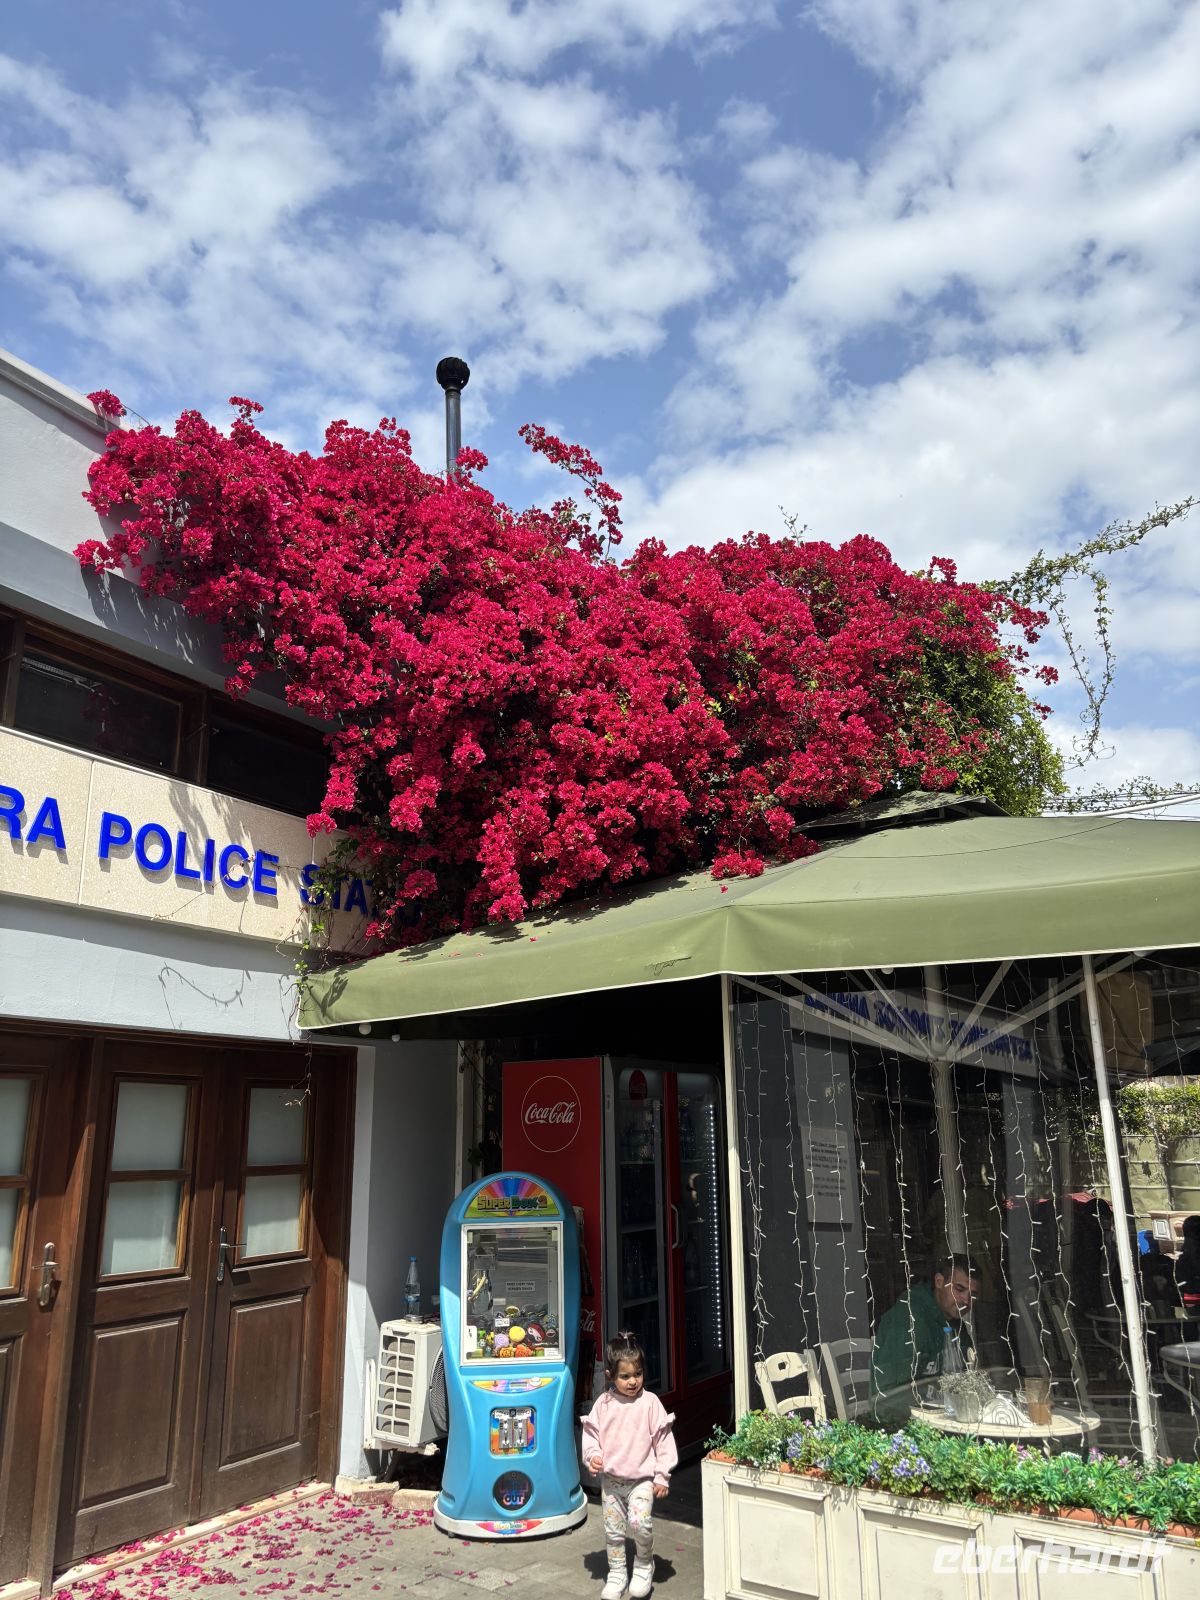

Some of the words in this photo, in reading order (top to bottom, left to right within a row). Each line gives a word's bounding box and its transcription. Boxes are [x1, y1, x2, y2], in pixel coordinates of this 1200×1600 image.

[98, 811, 279, 895] POLICE
[524, 1101, 578, 1125] Coca-Cola
[477, 1195, 511, 1210] SUPER
[503, 1493, 525, 1506] OUT
